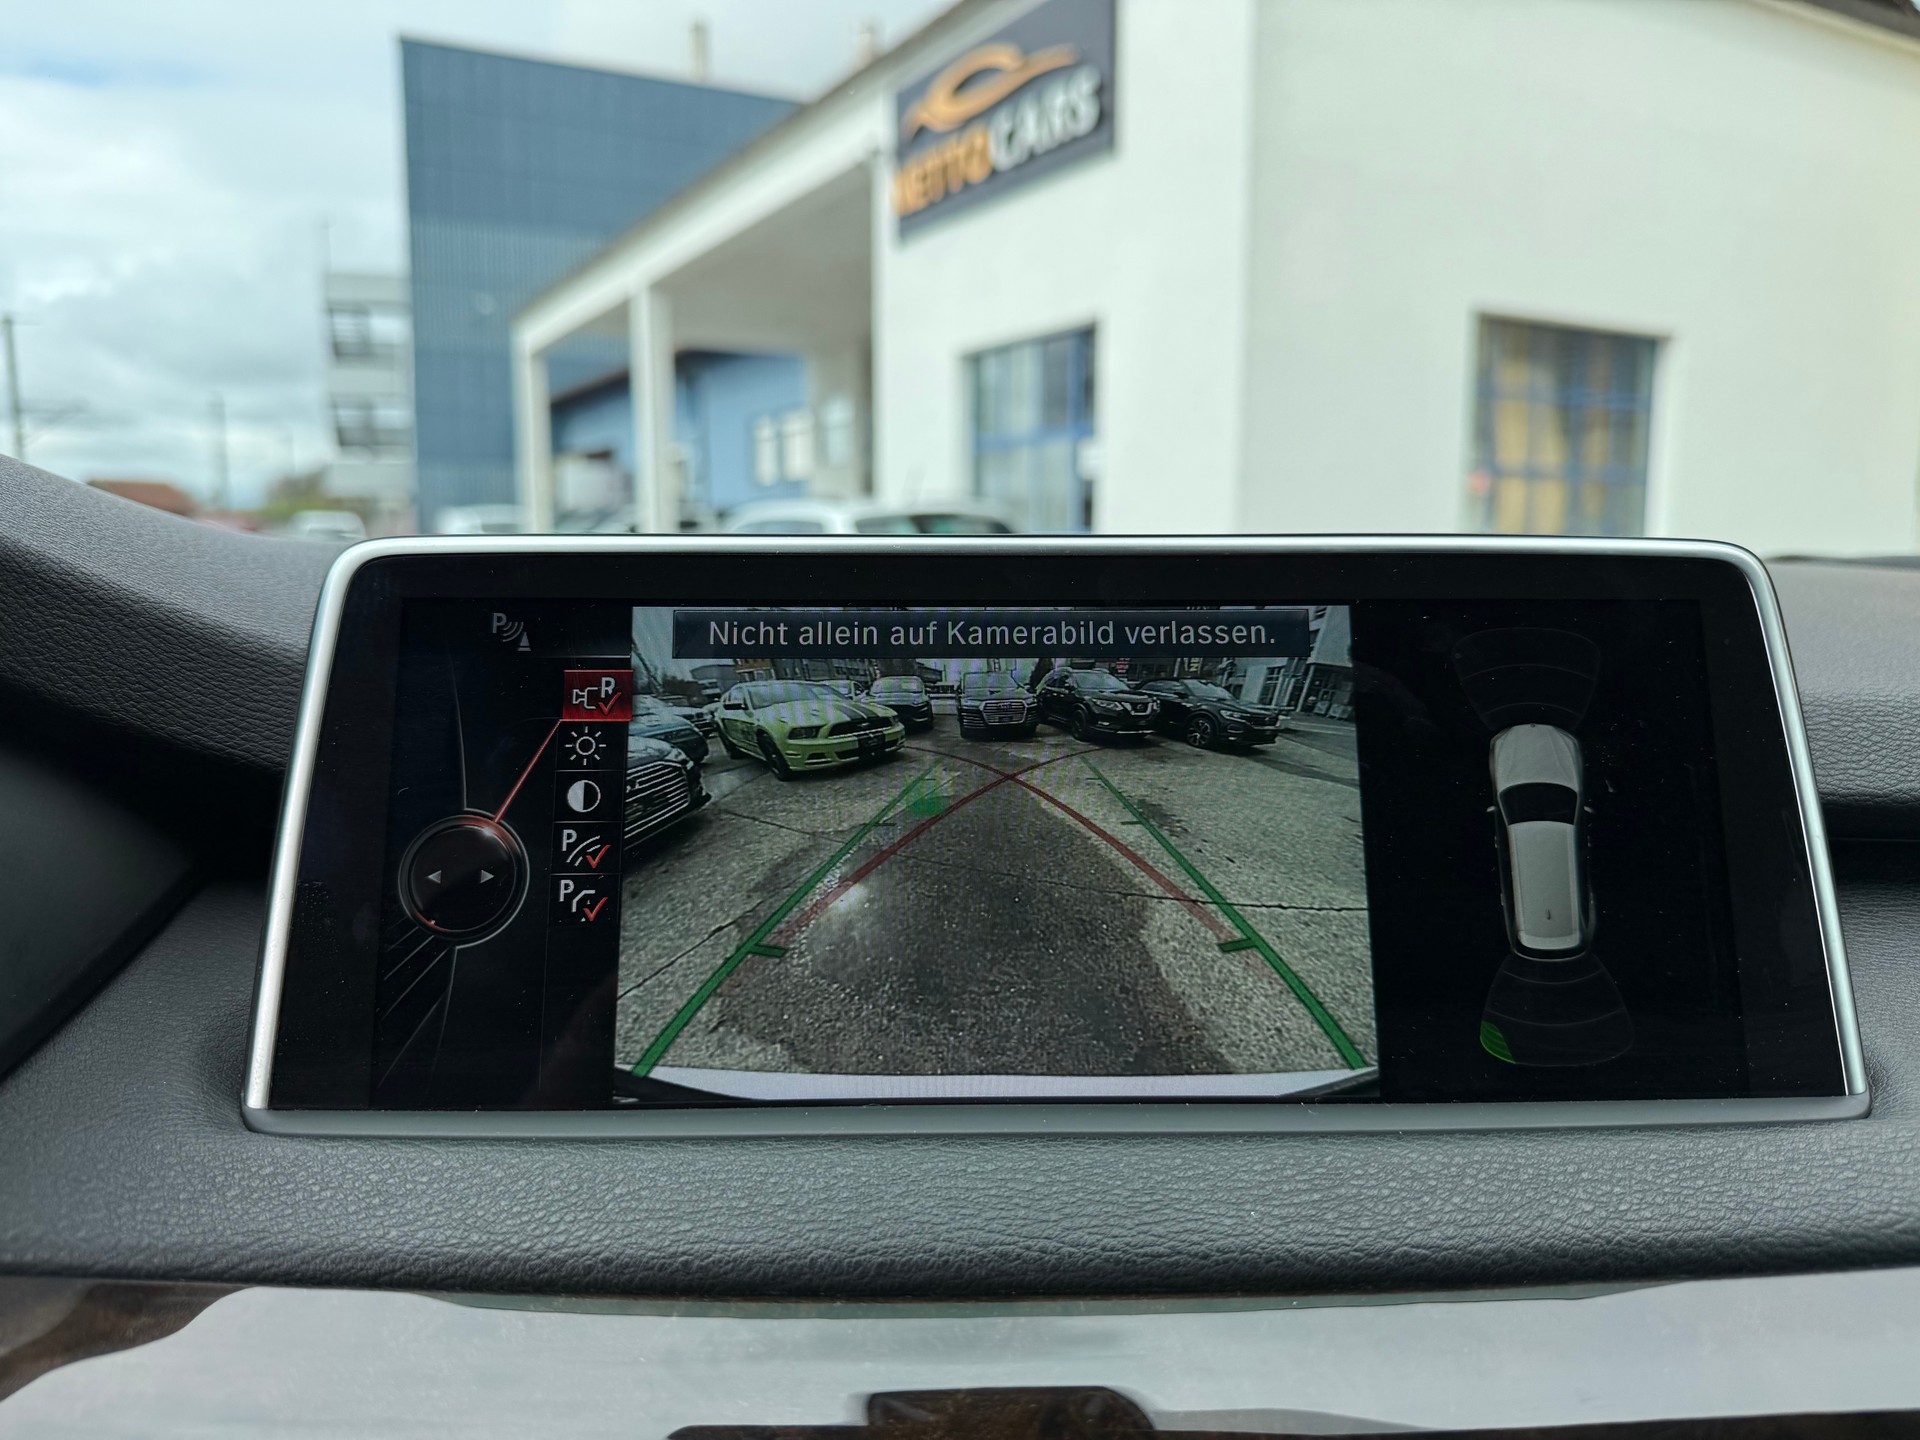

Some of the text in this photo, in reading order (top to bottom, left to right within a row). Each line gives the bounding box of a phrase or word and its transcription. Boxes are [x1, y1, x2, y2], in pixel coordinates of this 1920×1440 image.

[493, 612, 507, 634] P
[709, 620, 1276, 645] Nicht allein auf Kamerabild verlassen.
[562, 829, 577, 851] P
[559, 880, 574, 902] P
